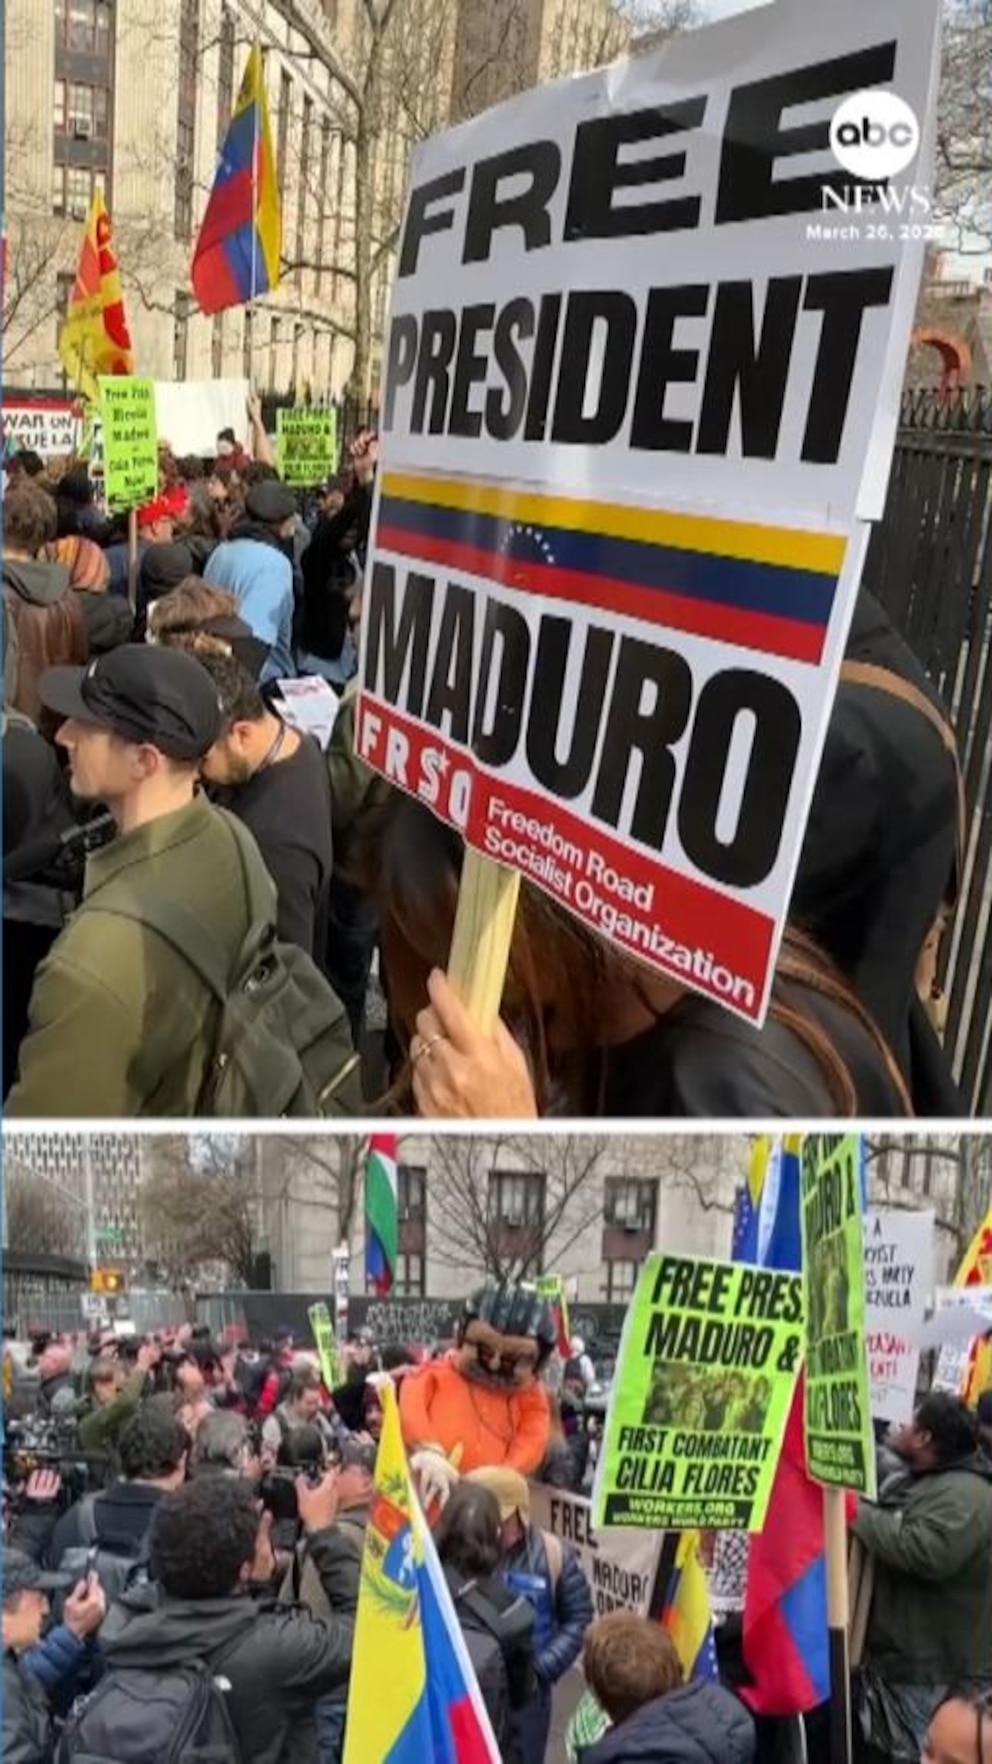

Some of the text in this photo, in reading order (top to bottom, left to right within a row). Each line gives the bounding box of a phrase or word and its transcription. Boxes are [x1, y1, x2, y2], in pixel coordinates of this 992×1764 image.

[399, 40, 898, 278] FREE
[384, 266, 894, 464] PRESIDENT
[3, 413, 71, 429] WAR ON
[364, 561, 801, 889] MADURO
[488, 796, 655, 913] Freedom Road
[484, 826, 756, 1008] Socialist Organization
[650, 1256, 804, 1324] FREE PRES.
[643, 1312, 775, 1368] MADURO
[776, 1334, 800, 1373] &
[616, 1456, 760, 1497] CILIA FLORES
[618, 1426, 772, 1462] FIRST COMBATANT
[628, 1498, 736, 1516] WORKERS.ORG
